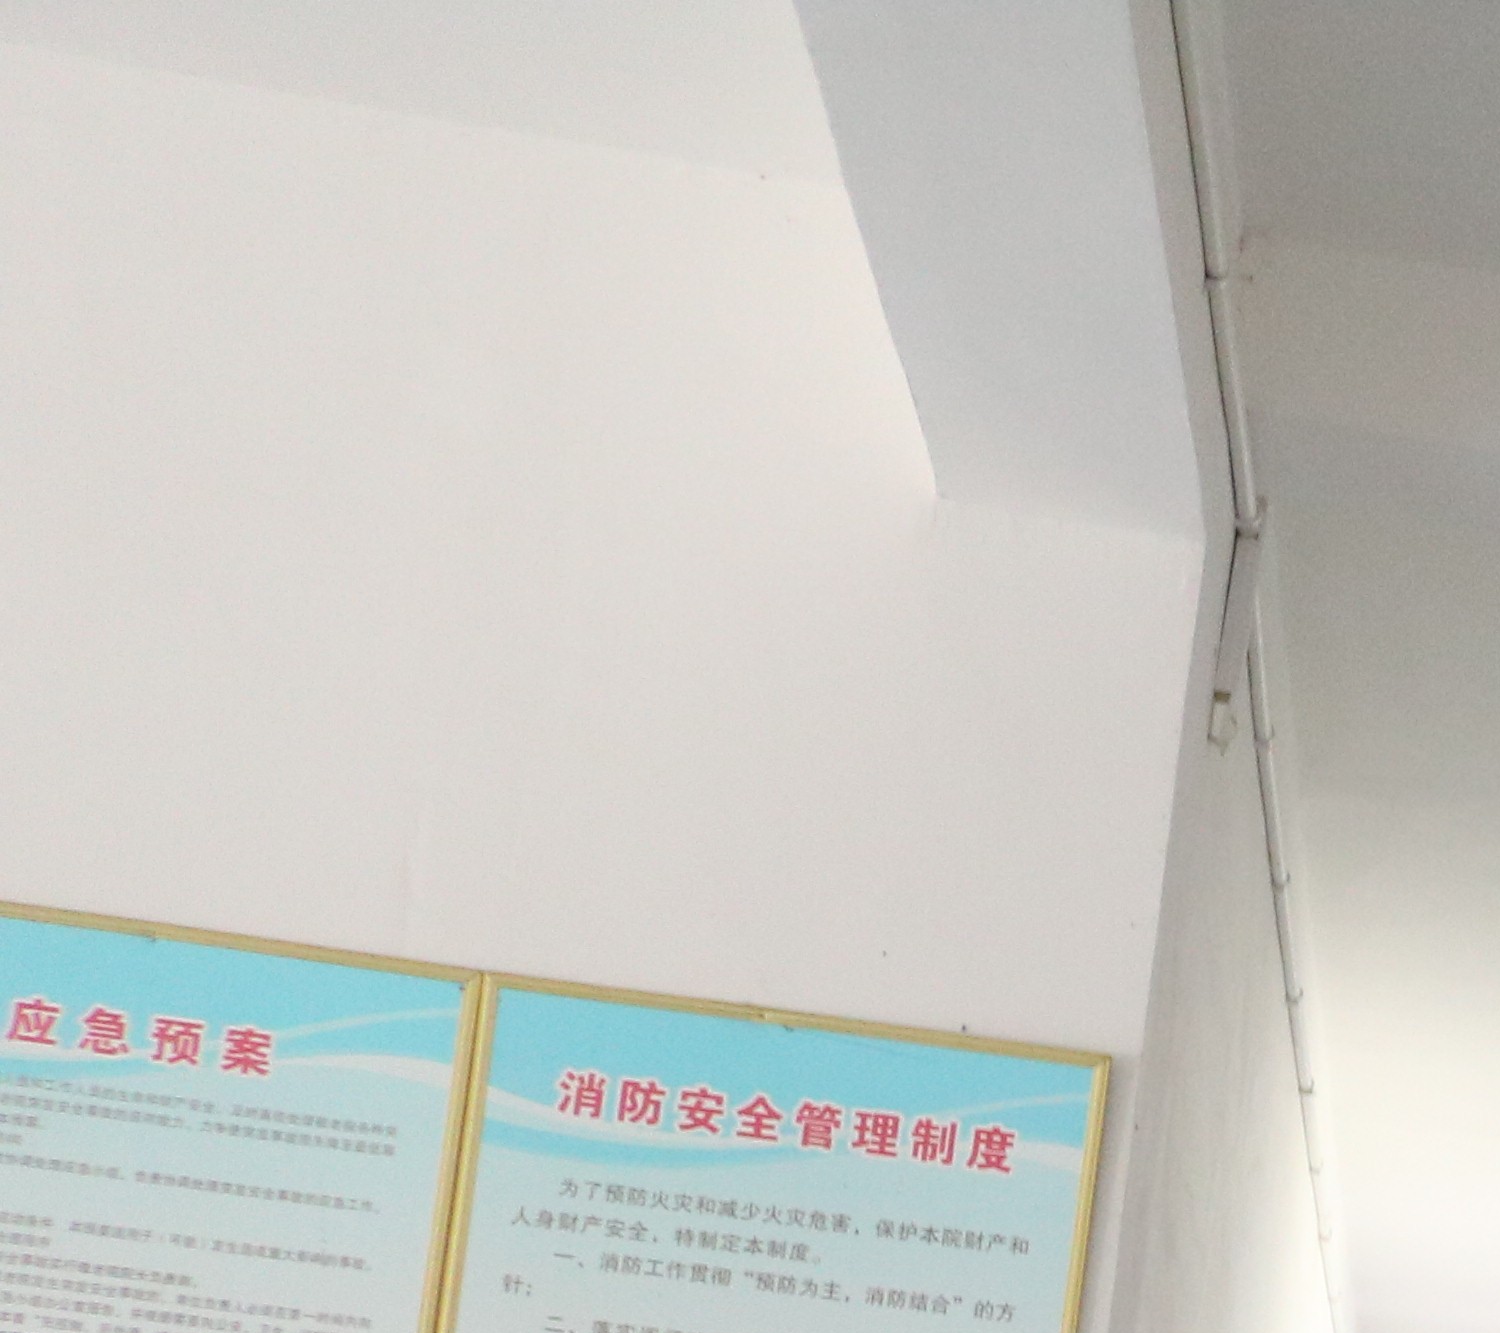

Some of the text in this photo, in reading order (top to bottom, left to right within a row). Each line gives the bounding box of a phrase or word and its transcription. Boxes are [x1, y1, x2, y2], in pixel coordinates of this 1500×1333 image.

[6, 1000, 273, 1076] 应急预案
[557, 1071, 1016, 1173] 消防安全管理制度
